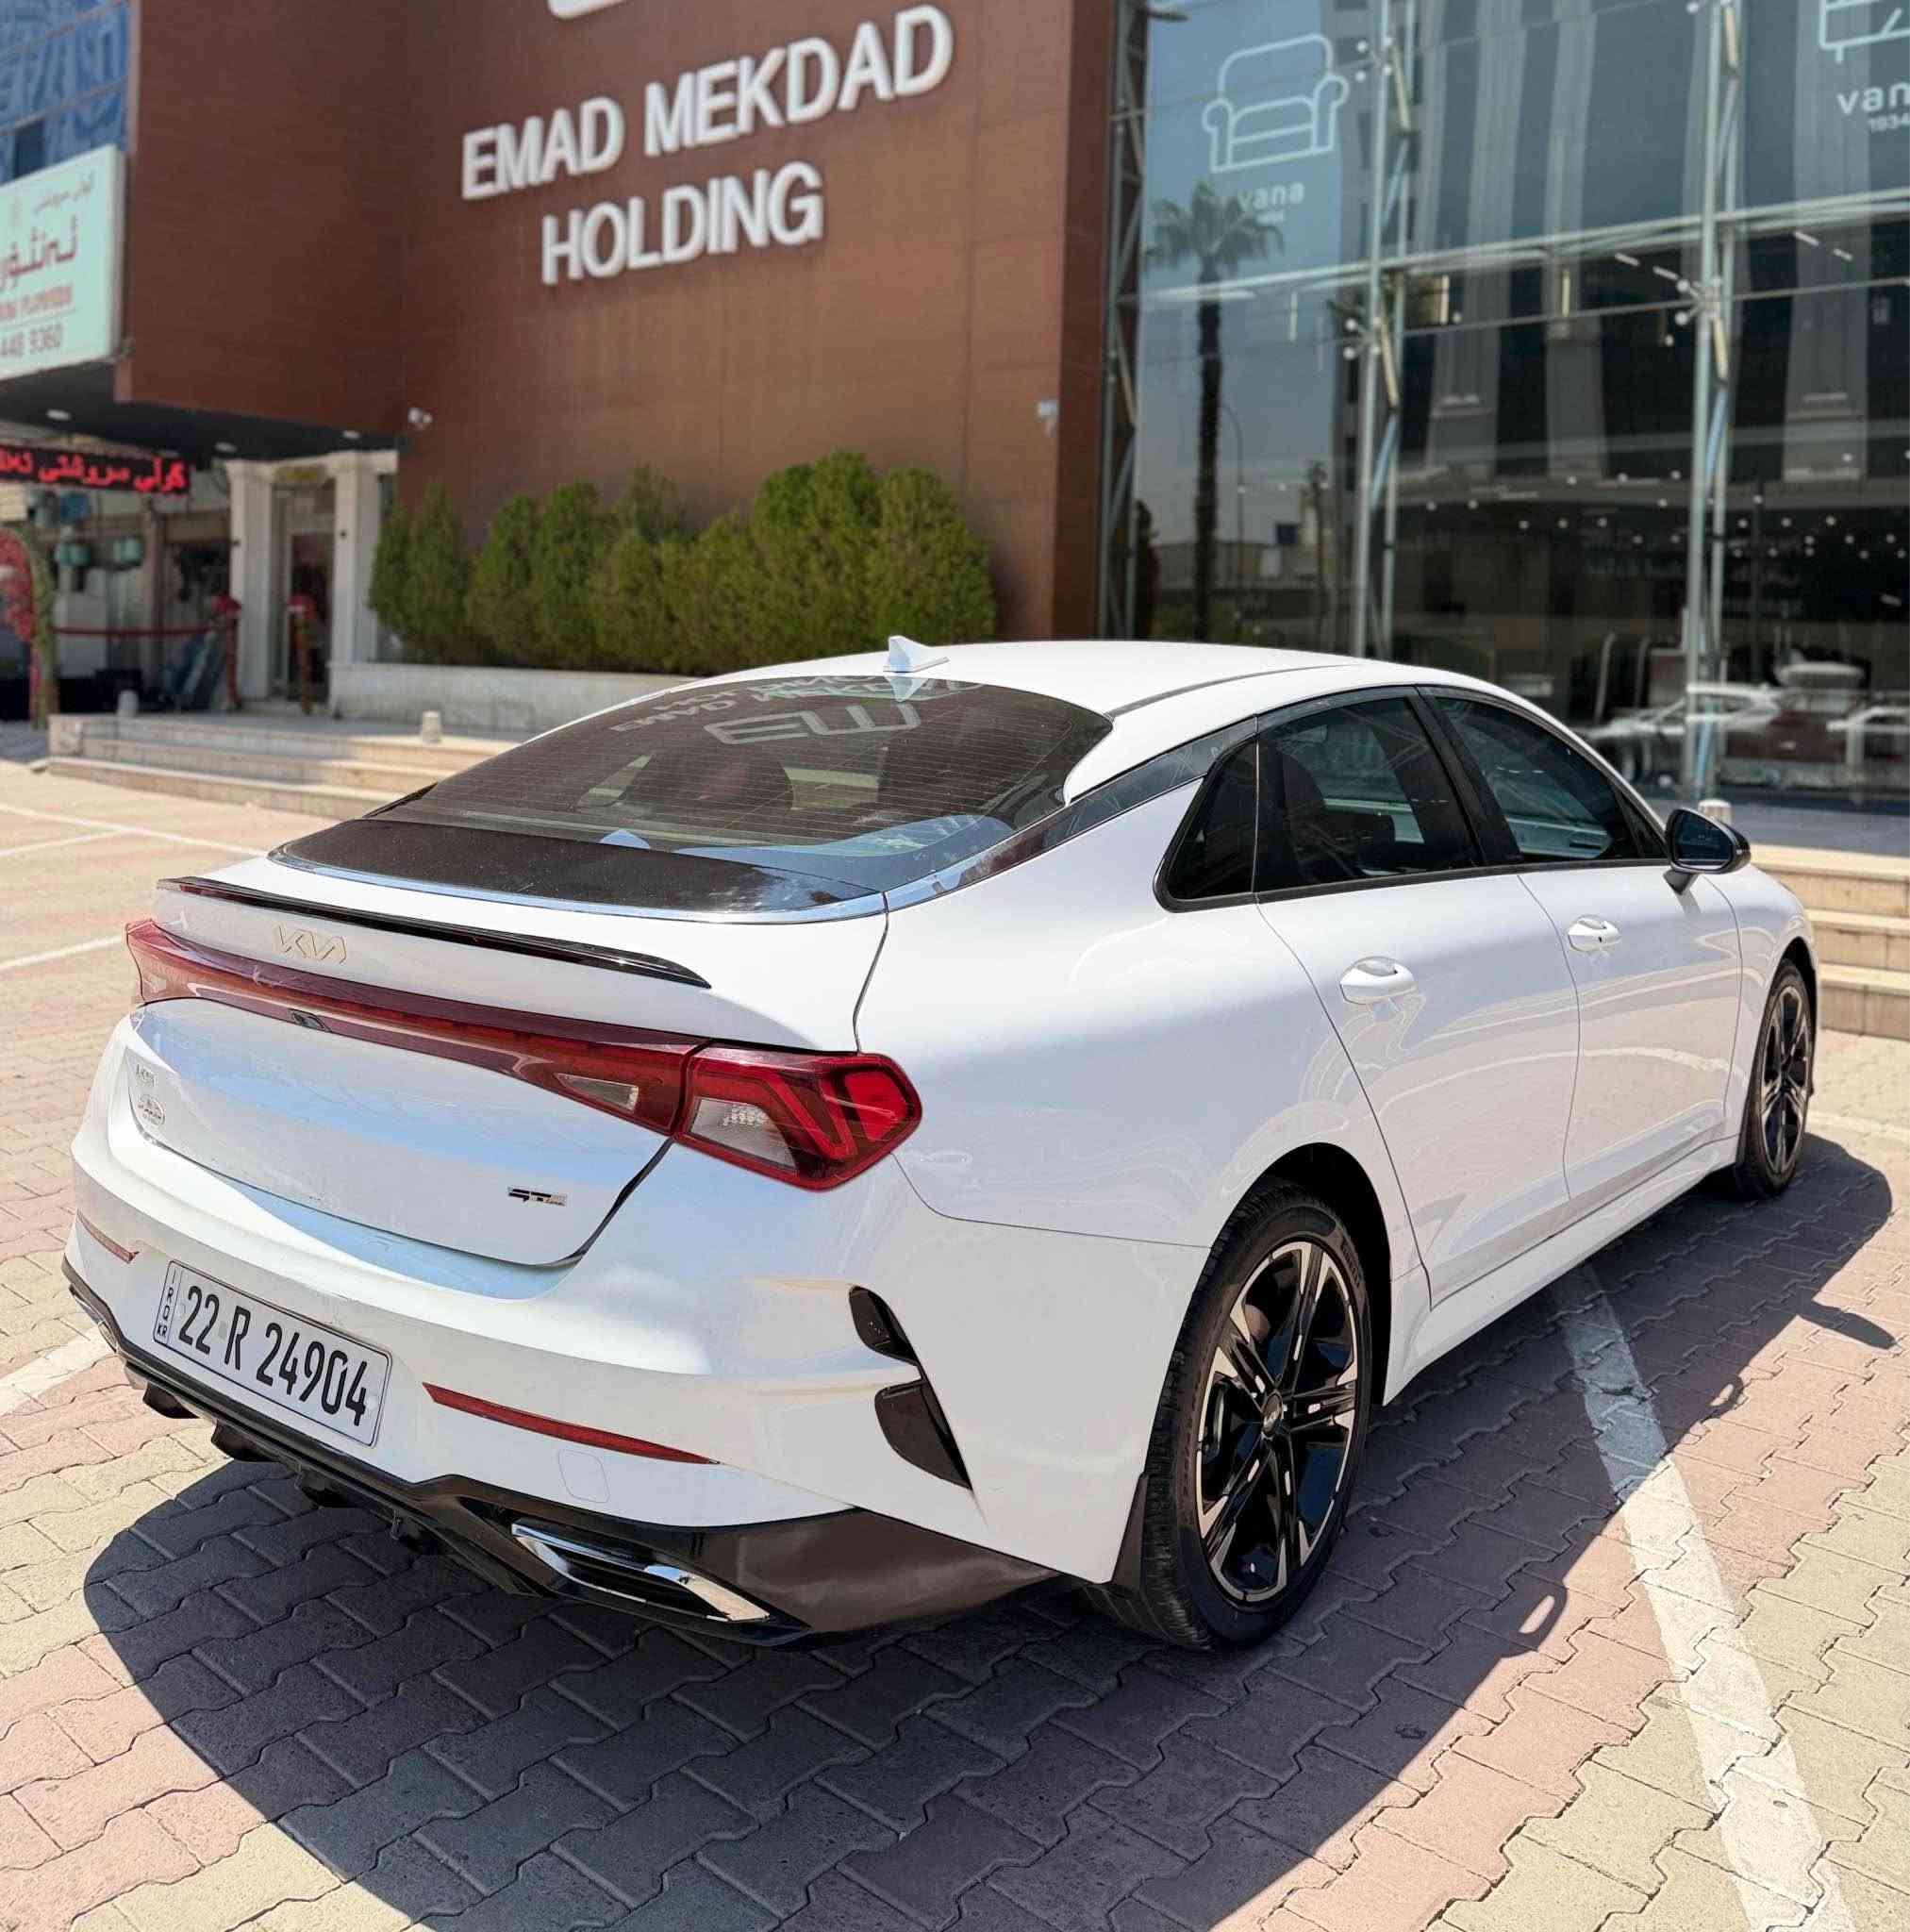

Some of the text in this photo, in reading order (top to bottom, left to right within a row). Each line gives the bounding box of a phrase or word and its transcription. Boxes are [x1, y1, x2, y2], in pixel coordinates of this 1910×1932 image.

[462, 5, 953, 199] EMAD MEKDAD
[541, 161, 823, 284] HOLDING
[1237, 182, 1305, 212] vana
[178, 1286, 368, 1426] 22 R 24904
